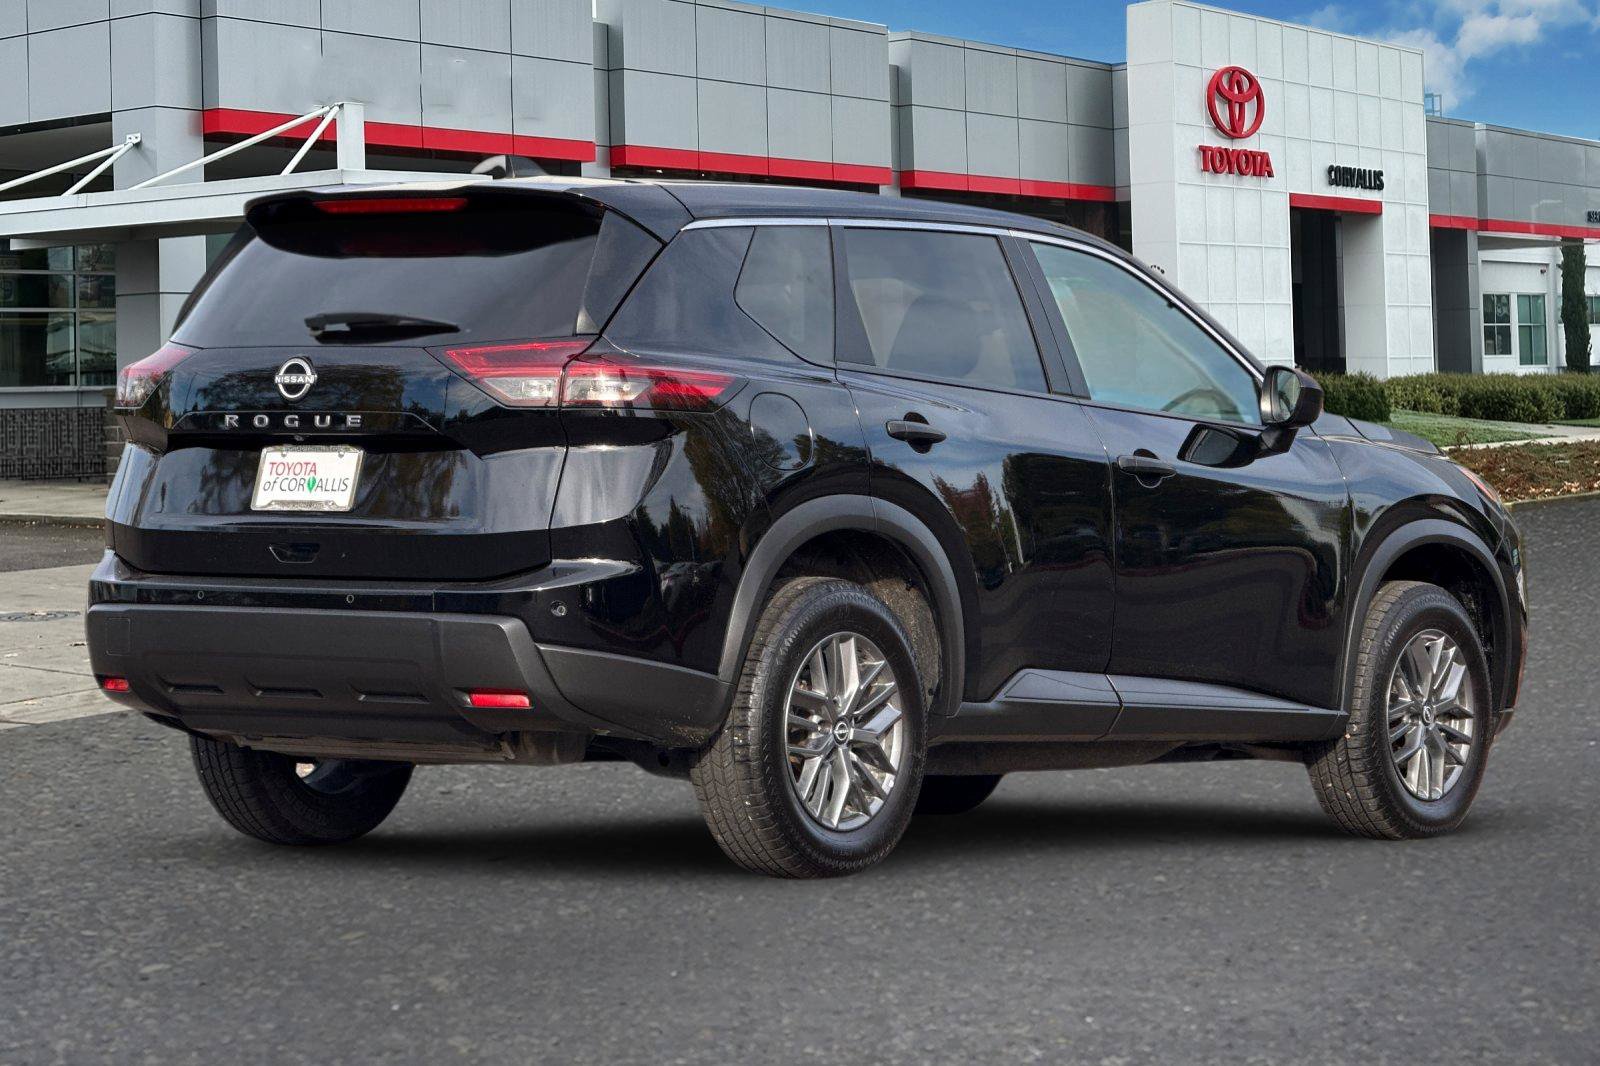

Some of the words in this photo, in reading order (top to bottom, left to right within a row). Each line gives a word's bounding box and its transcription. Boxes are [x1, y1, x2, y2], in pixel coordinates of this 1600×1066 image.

[1199, 145, 1275, 178] TOYOTA
[1327, 164, 1385, 191] CORVALLIS
[274, 373, 316, 385] NISSAN
[224, 414, 362, 428] ROGUE
[269, 462, 317, 476] TOYOTA
